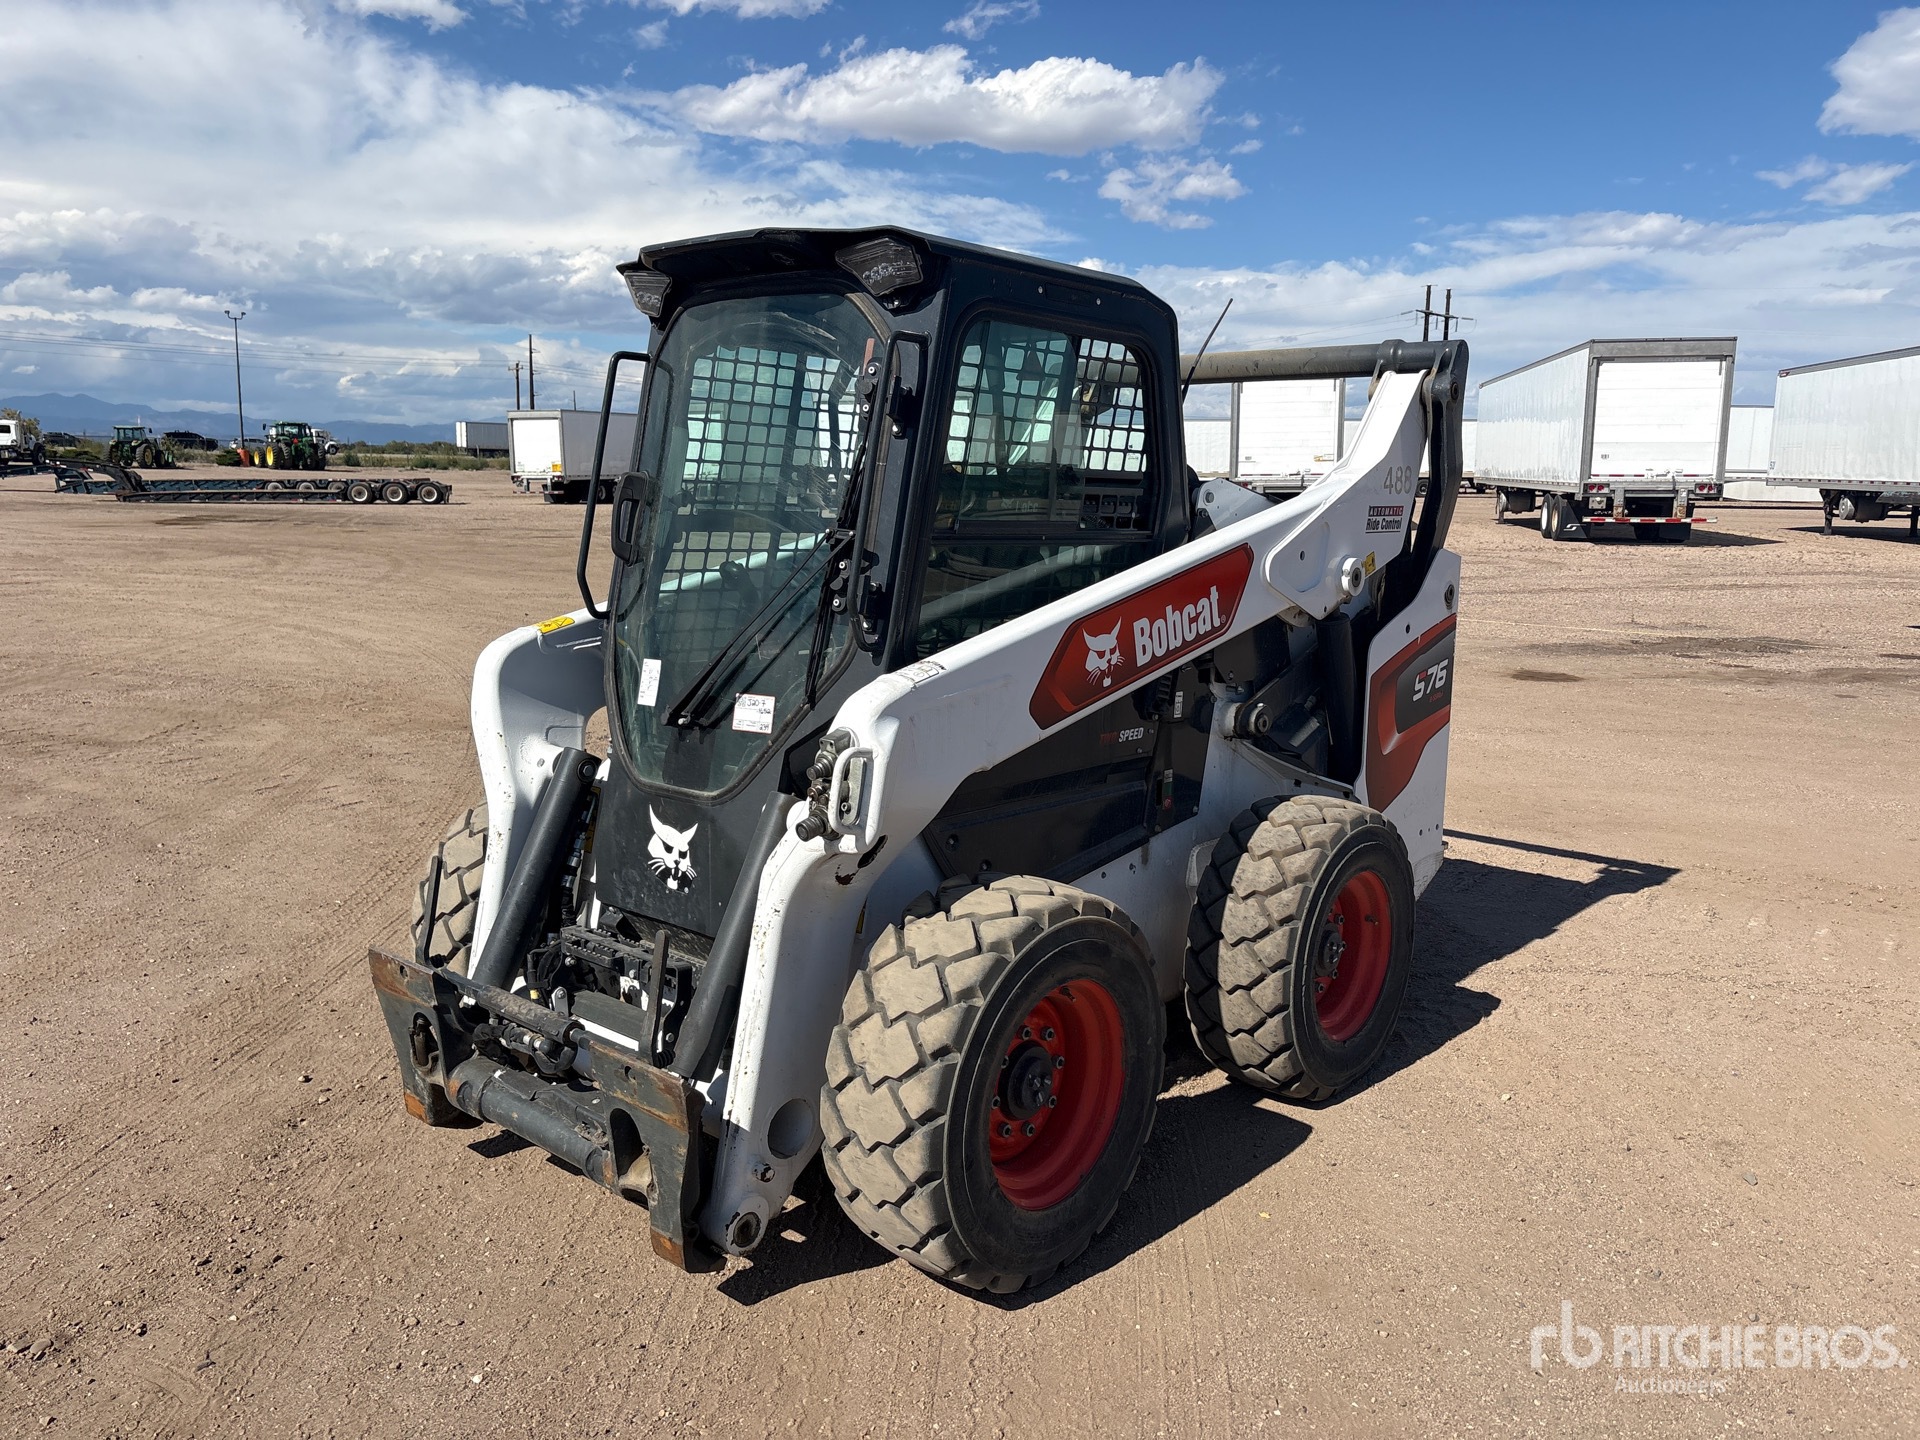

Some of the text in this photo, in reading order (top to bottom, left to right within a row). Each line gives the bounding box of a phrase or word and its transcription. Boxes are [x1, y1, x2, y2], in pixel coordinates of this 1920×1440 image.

[1383, 466, 1412, 494] 488
[1369, 507, 1403, 516] AUTOMATIC
[1366, 517, 1402, 531] Ride Control
[1133, 585, 1220, 667] Bobcat
[1413, 659, 1449, 702] S76
[1118, 727, 1144, 742] SPEED
